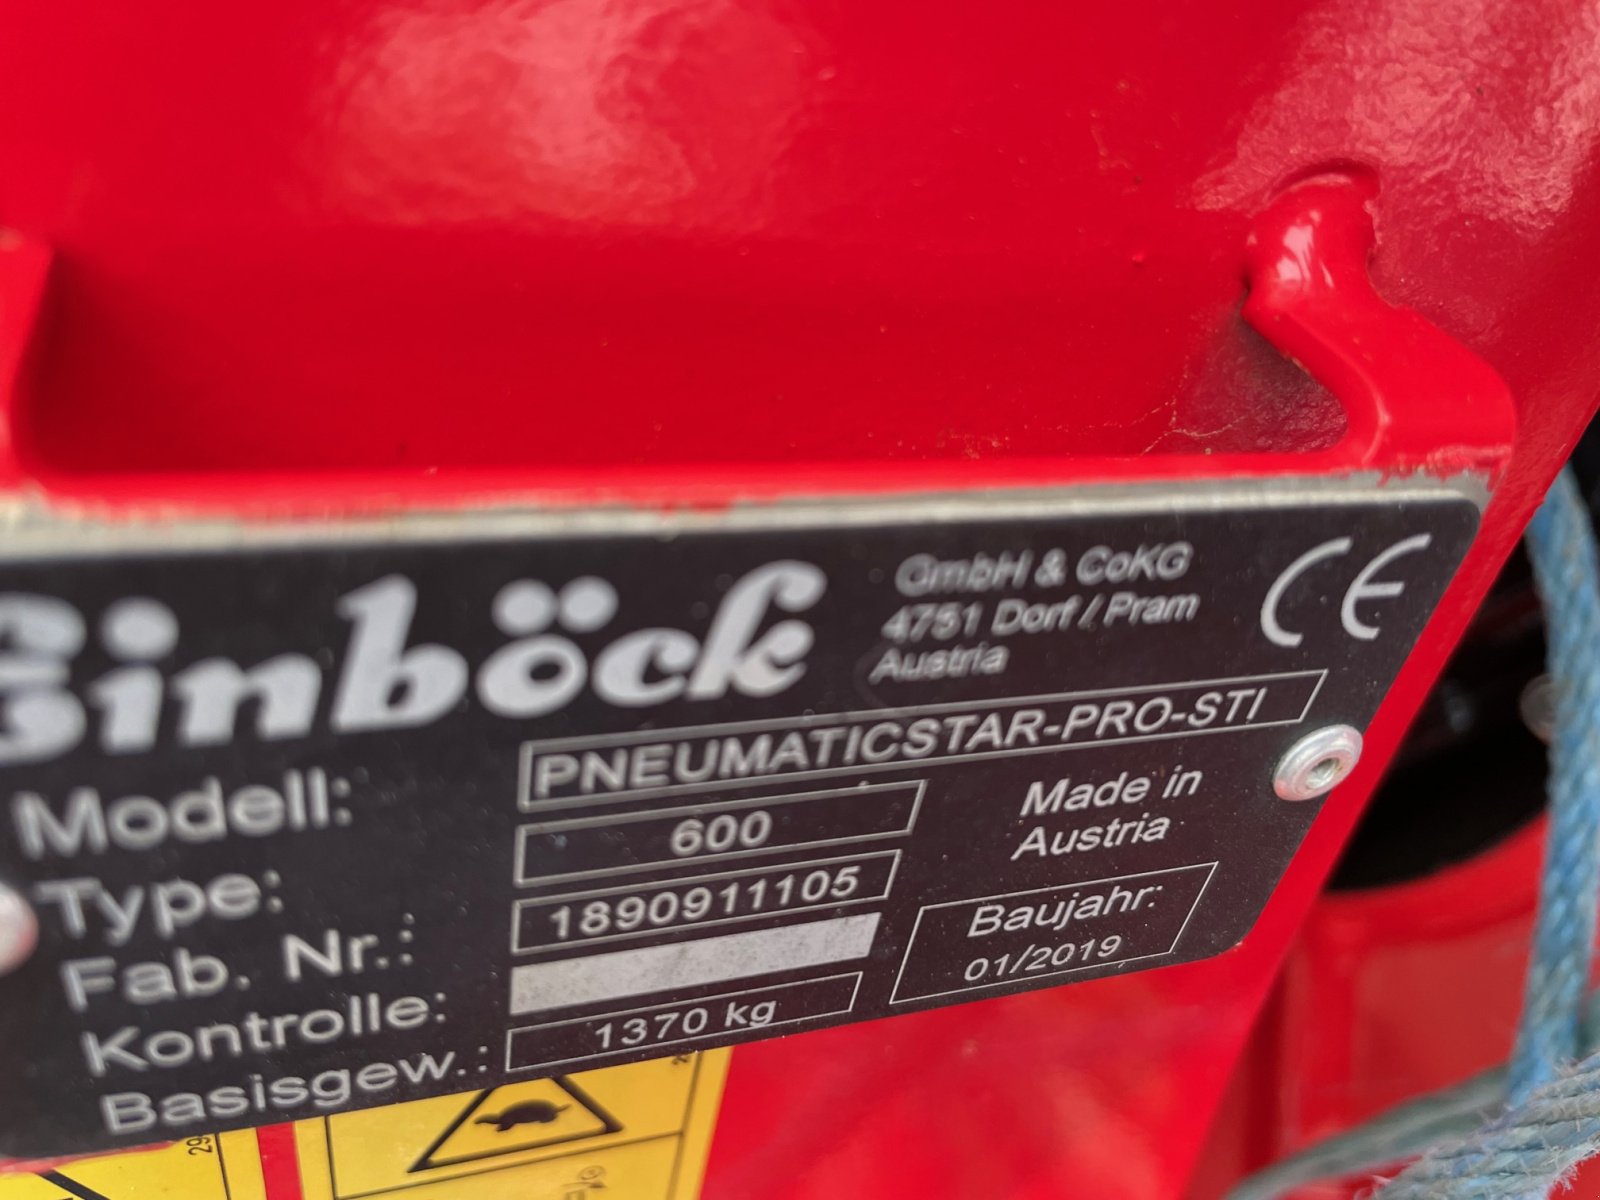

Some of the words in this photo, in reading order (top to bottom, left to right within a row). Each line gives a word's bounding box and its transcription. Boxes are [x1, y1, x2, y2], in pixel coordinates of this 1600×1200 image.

[897, 555, 1026, 598] GmbH
[1034, 550, 1065, 575] &
[1077, 543, 1194, 584] CoKG
[1260, 533, 1432, 648] CE
[880, 603, 979, 642] 4751
[992, 598, 1077, 633] Dorf
[1083, 599, 1099, 628] /
[1103, 591, 1198, 624] Pram
[869, 643, 1009, 684] Austria
[536, 687, 1267, 797] PNEUMATICSTAR-PRO-STI
[14, 768, 354, 856] Modell:
[1020, 776, 1149, 816] Made
[1166, 766, 1202, 798] in
[670, 810, 771, 856] 600
[1011, 812, 1170, 860] Austria
[36, 868, 283, 946] Type:
[550, 866, 861, 940] 1890911105
[968, 884, 1162, 936] Baujahr:
[63, 948, 250, 1010] Fab.
[284, 928, 414, 980] Nr.:
[964, 934, 1122, 982] 01/2019
[82, 992, 447, 1076] Kontrolle:
[594, 1008, 710, 1052] 1370
[725, 996, 778, 1030] kg
[102, 1042, 490, 1134] Basisgew.:
